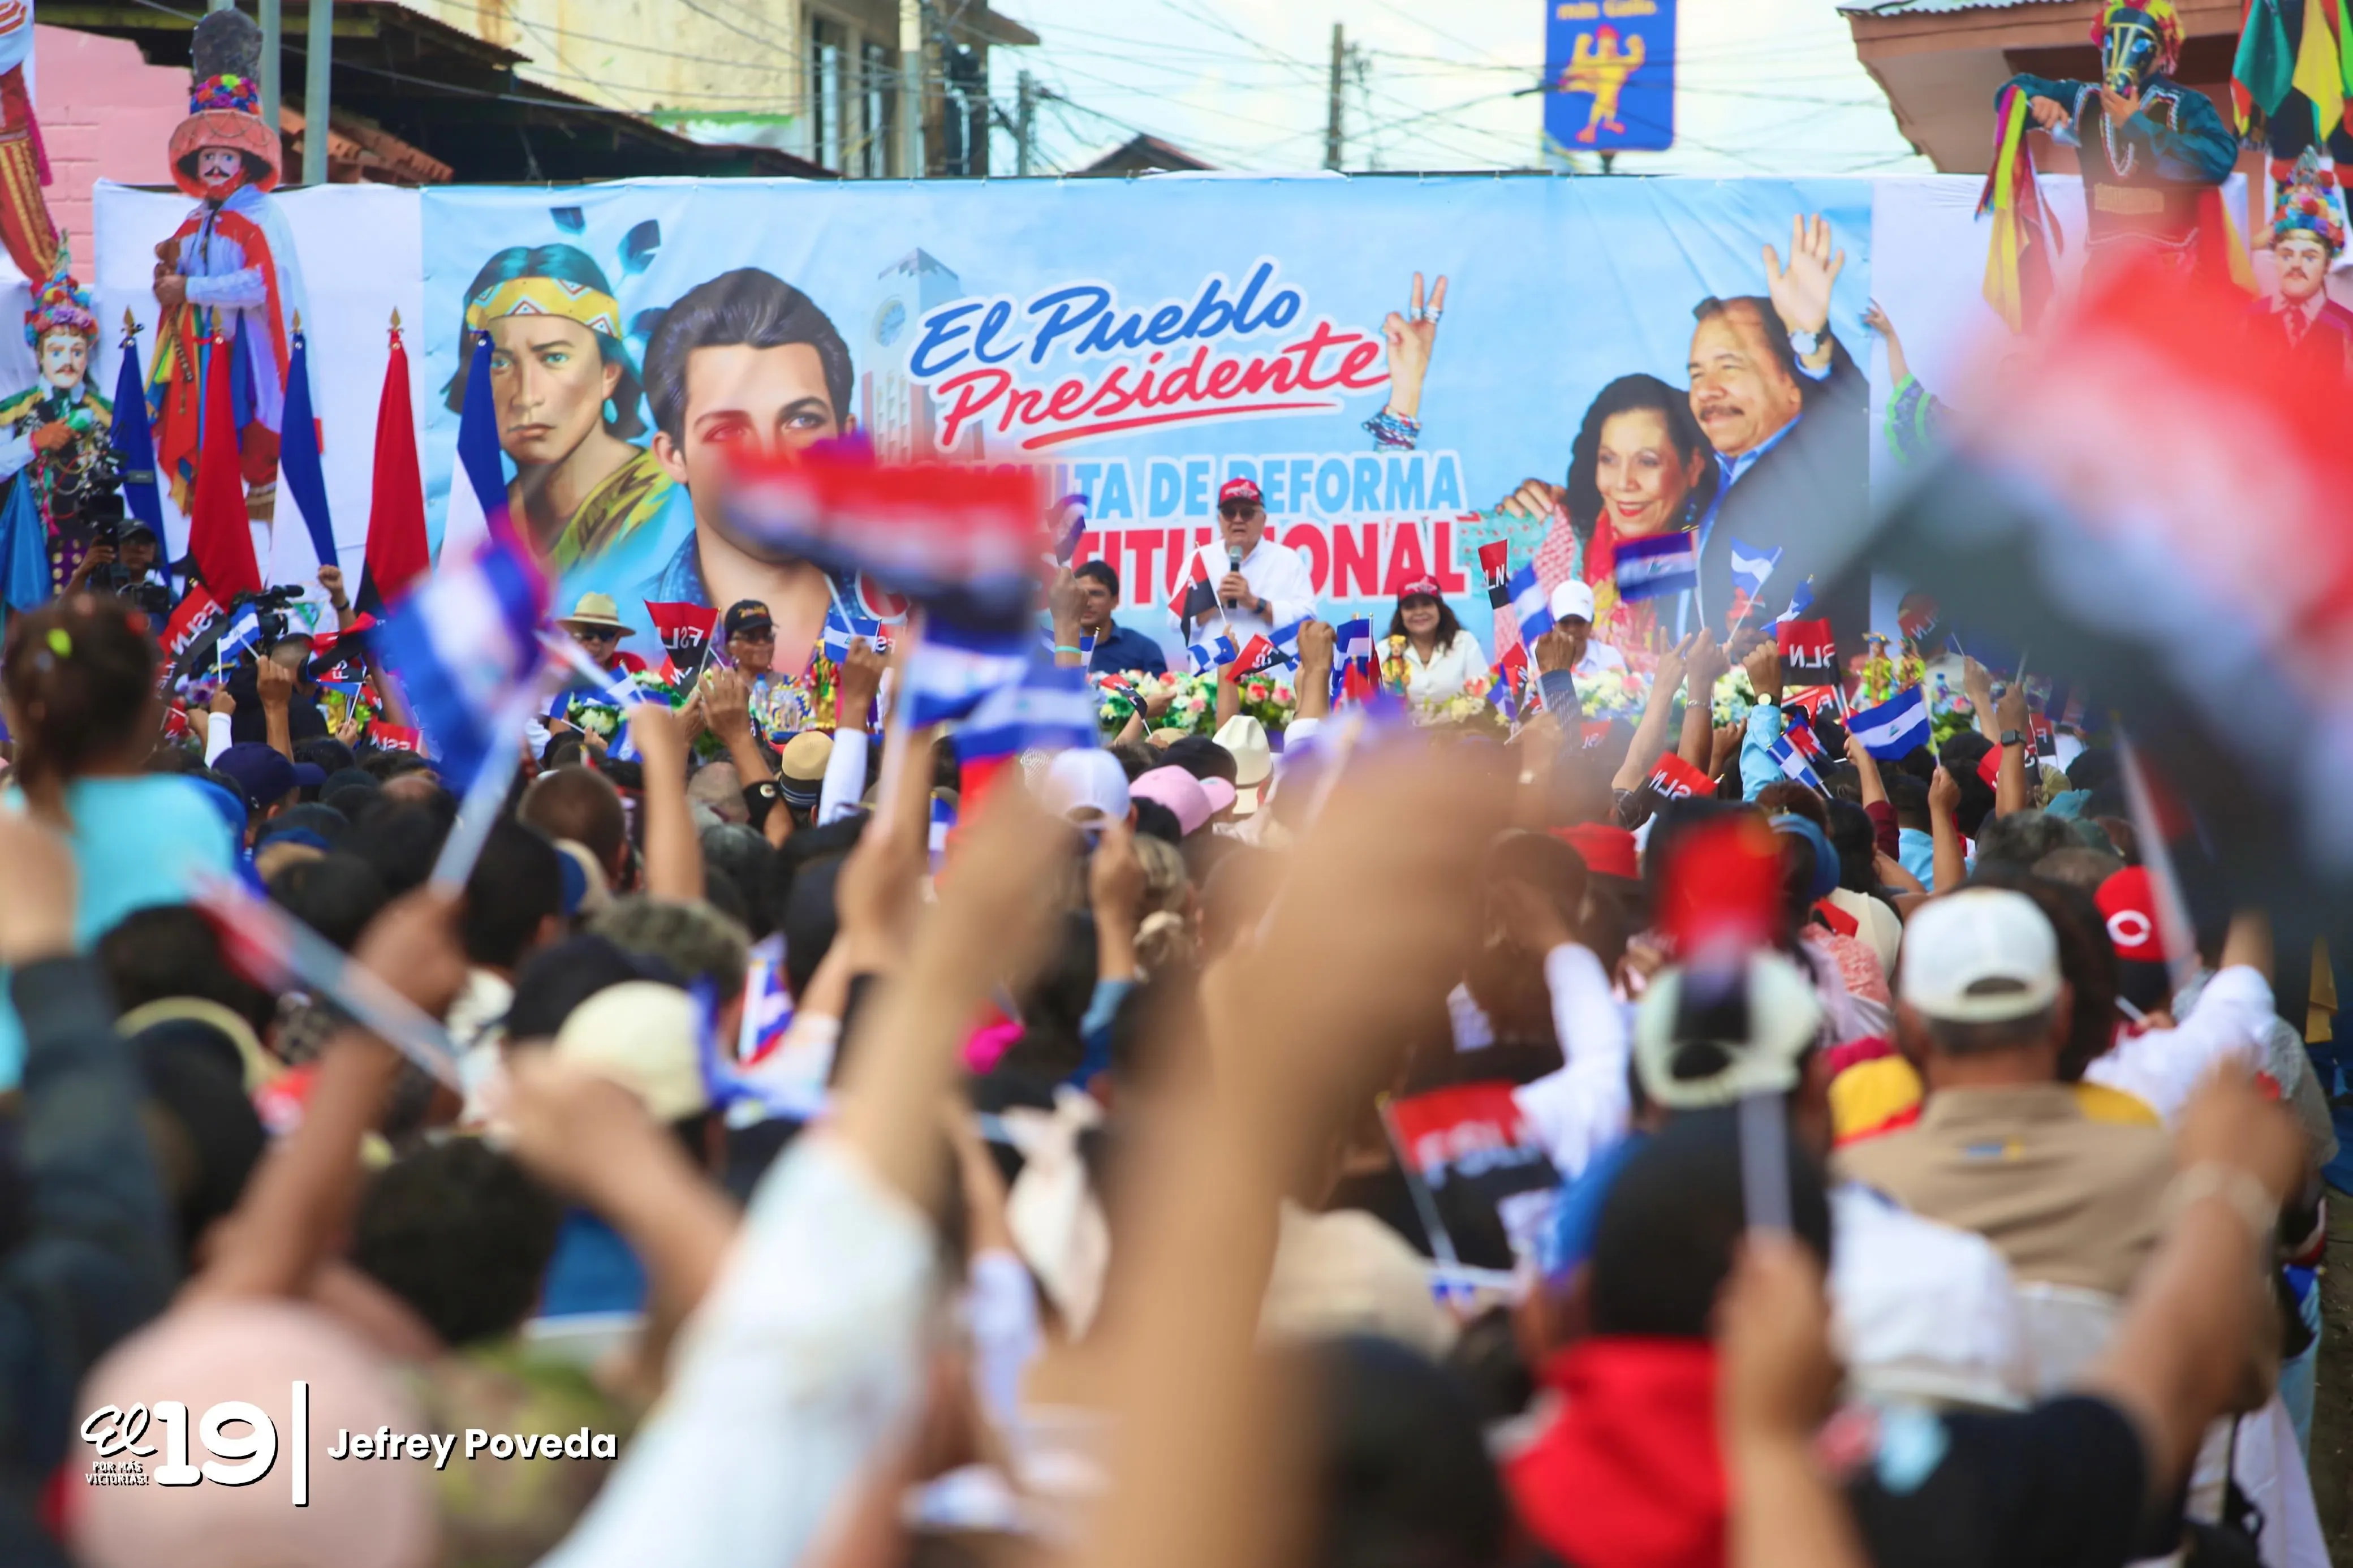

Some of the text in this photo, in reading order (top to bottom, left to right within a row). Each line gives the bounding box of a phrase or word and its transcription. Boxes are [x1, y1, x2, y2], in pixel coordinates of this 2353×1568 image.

[910, 262, 1300, 377] El Pueblo
[937, 321, 1390, 447] Presidente
[1149, 460, 1209, 517] DE
[1485, 563, 1505, 591] LN
